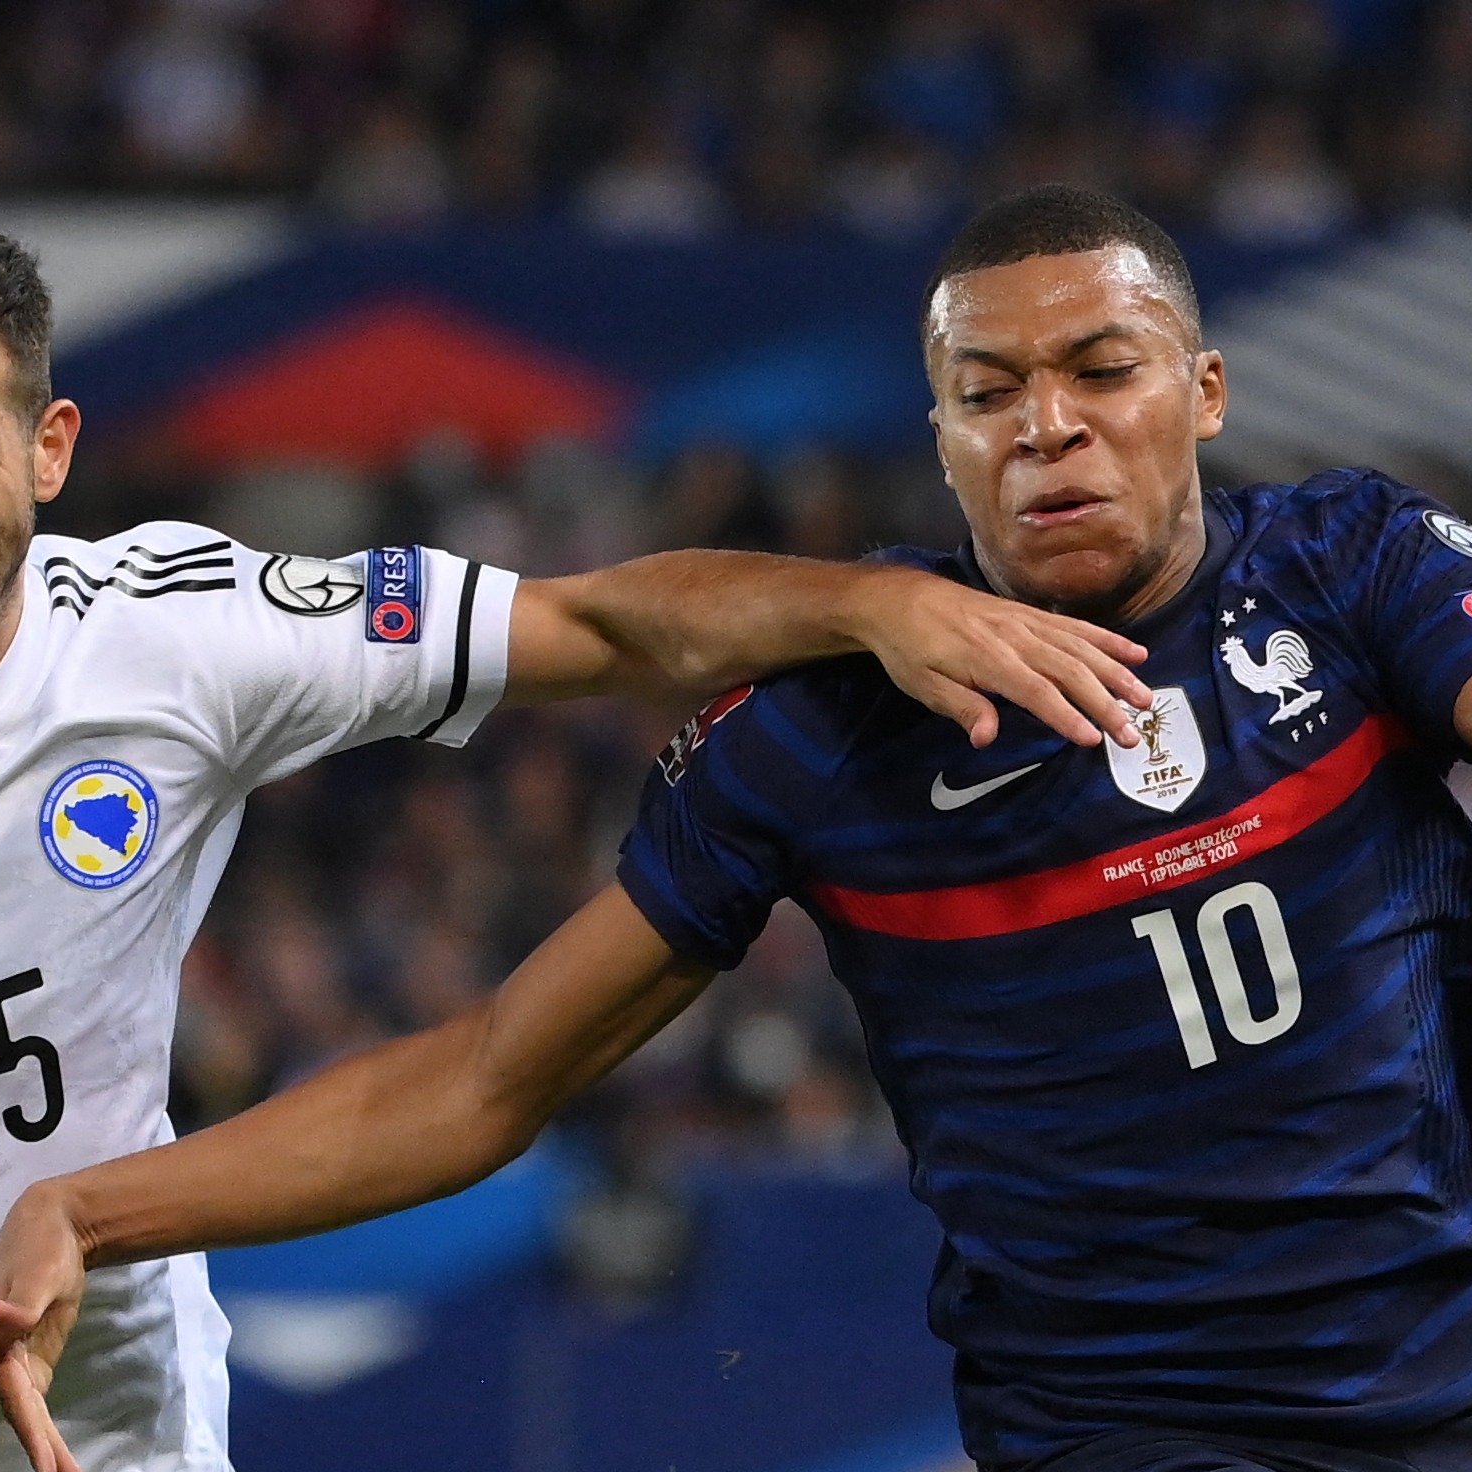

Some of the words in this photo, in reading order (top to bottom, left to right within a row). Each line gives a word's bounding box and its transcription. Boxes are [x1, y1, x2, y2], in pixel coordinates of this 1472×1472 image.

[1156, 787, 1178, 799] 2018
[1103, 857, 1147, 882] FRANCE
[1140, 872, 1149, 887] 1
[1150, 853, 1208, 884] SEPTEMBRE
[1207, 840, 1239, 864] 2021
[1131, 881, 1302, 1070] 10
